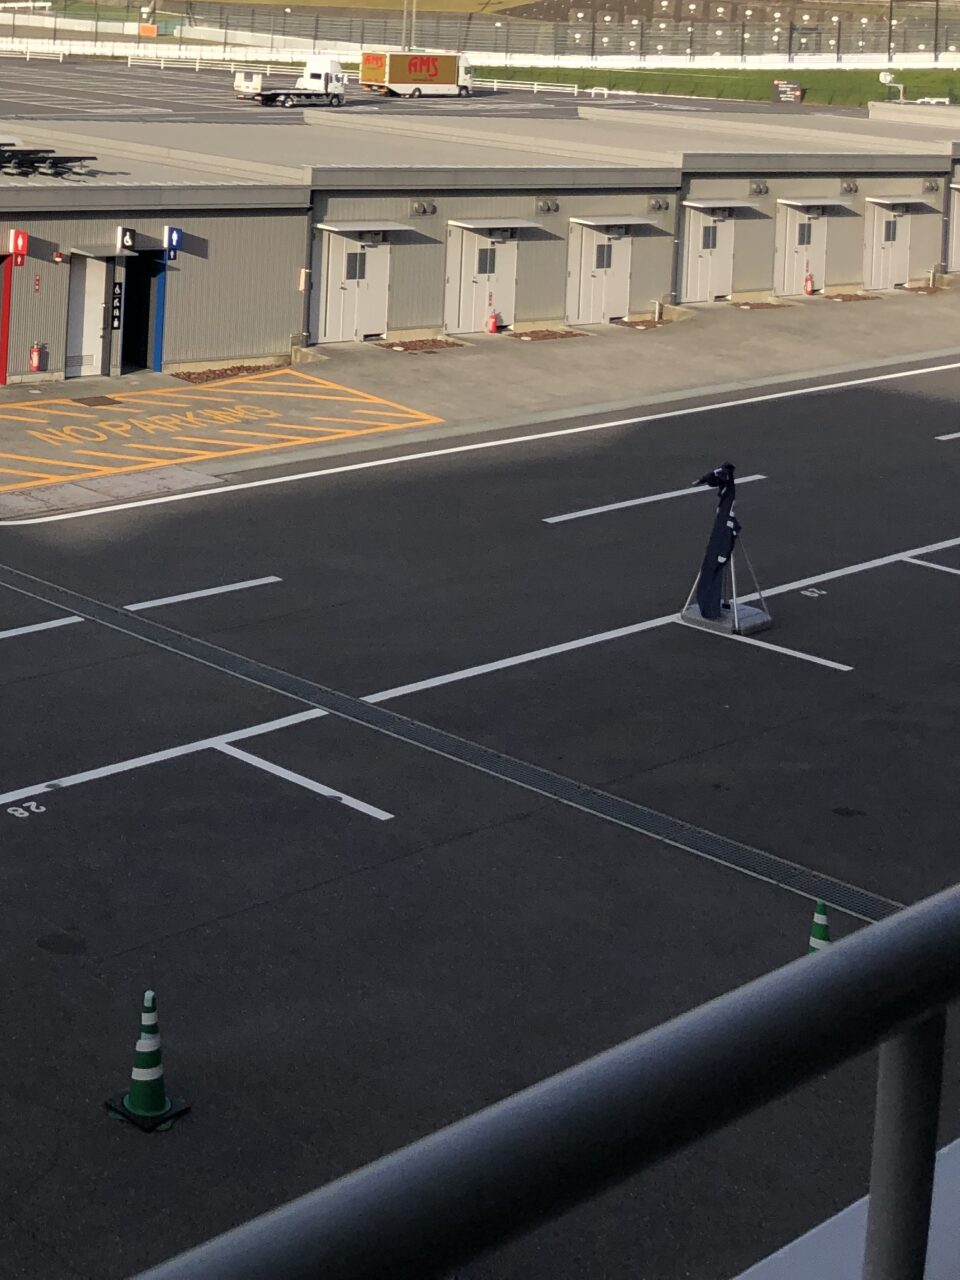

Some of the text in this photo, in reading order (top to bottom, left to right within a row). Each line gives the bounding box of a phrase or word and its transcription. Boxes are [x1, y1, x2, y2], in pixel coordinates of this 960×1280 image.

[26, 404, 283, 446] NO PARKING
[7, 801, 47, 819] 28
